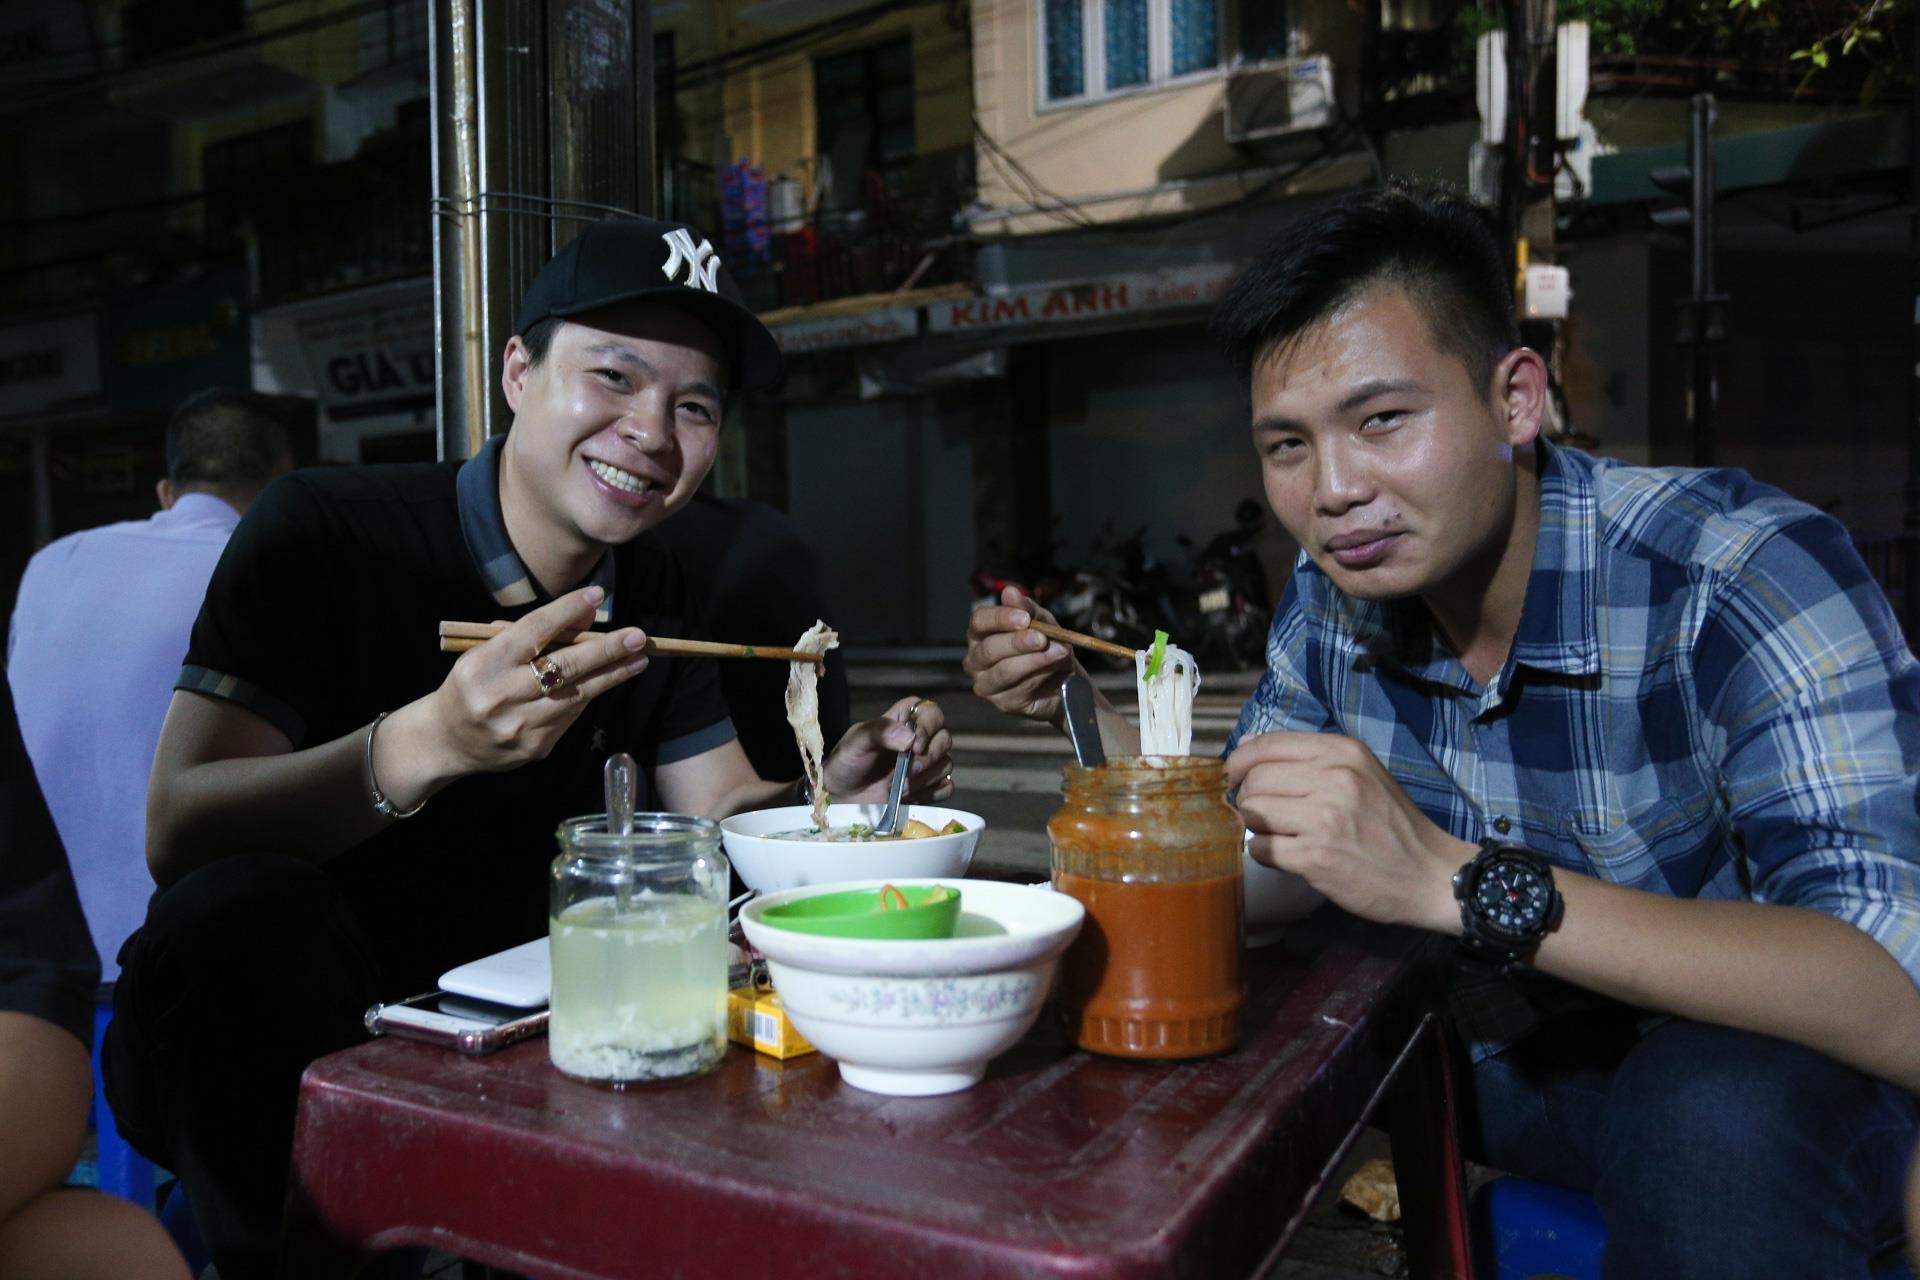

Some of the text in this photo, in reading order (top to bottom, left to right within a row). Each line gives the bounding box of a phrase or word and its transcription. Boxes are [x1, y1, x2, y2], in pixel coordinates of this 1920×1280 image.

[661, 228, 721, 294] NY
[952, 296, 1029, 327] KIM
[1041, 285, 1129, 319] ANH
[329, 352, 404, 396] GIA
